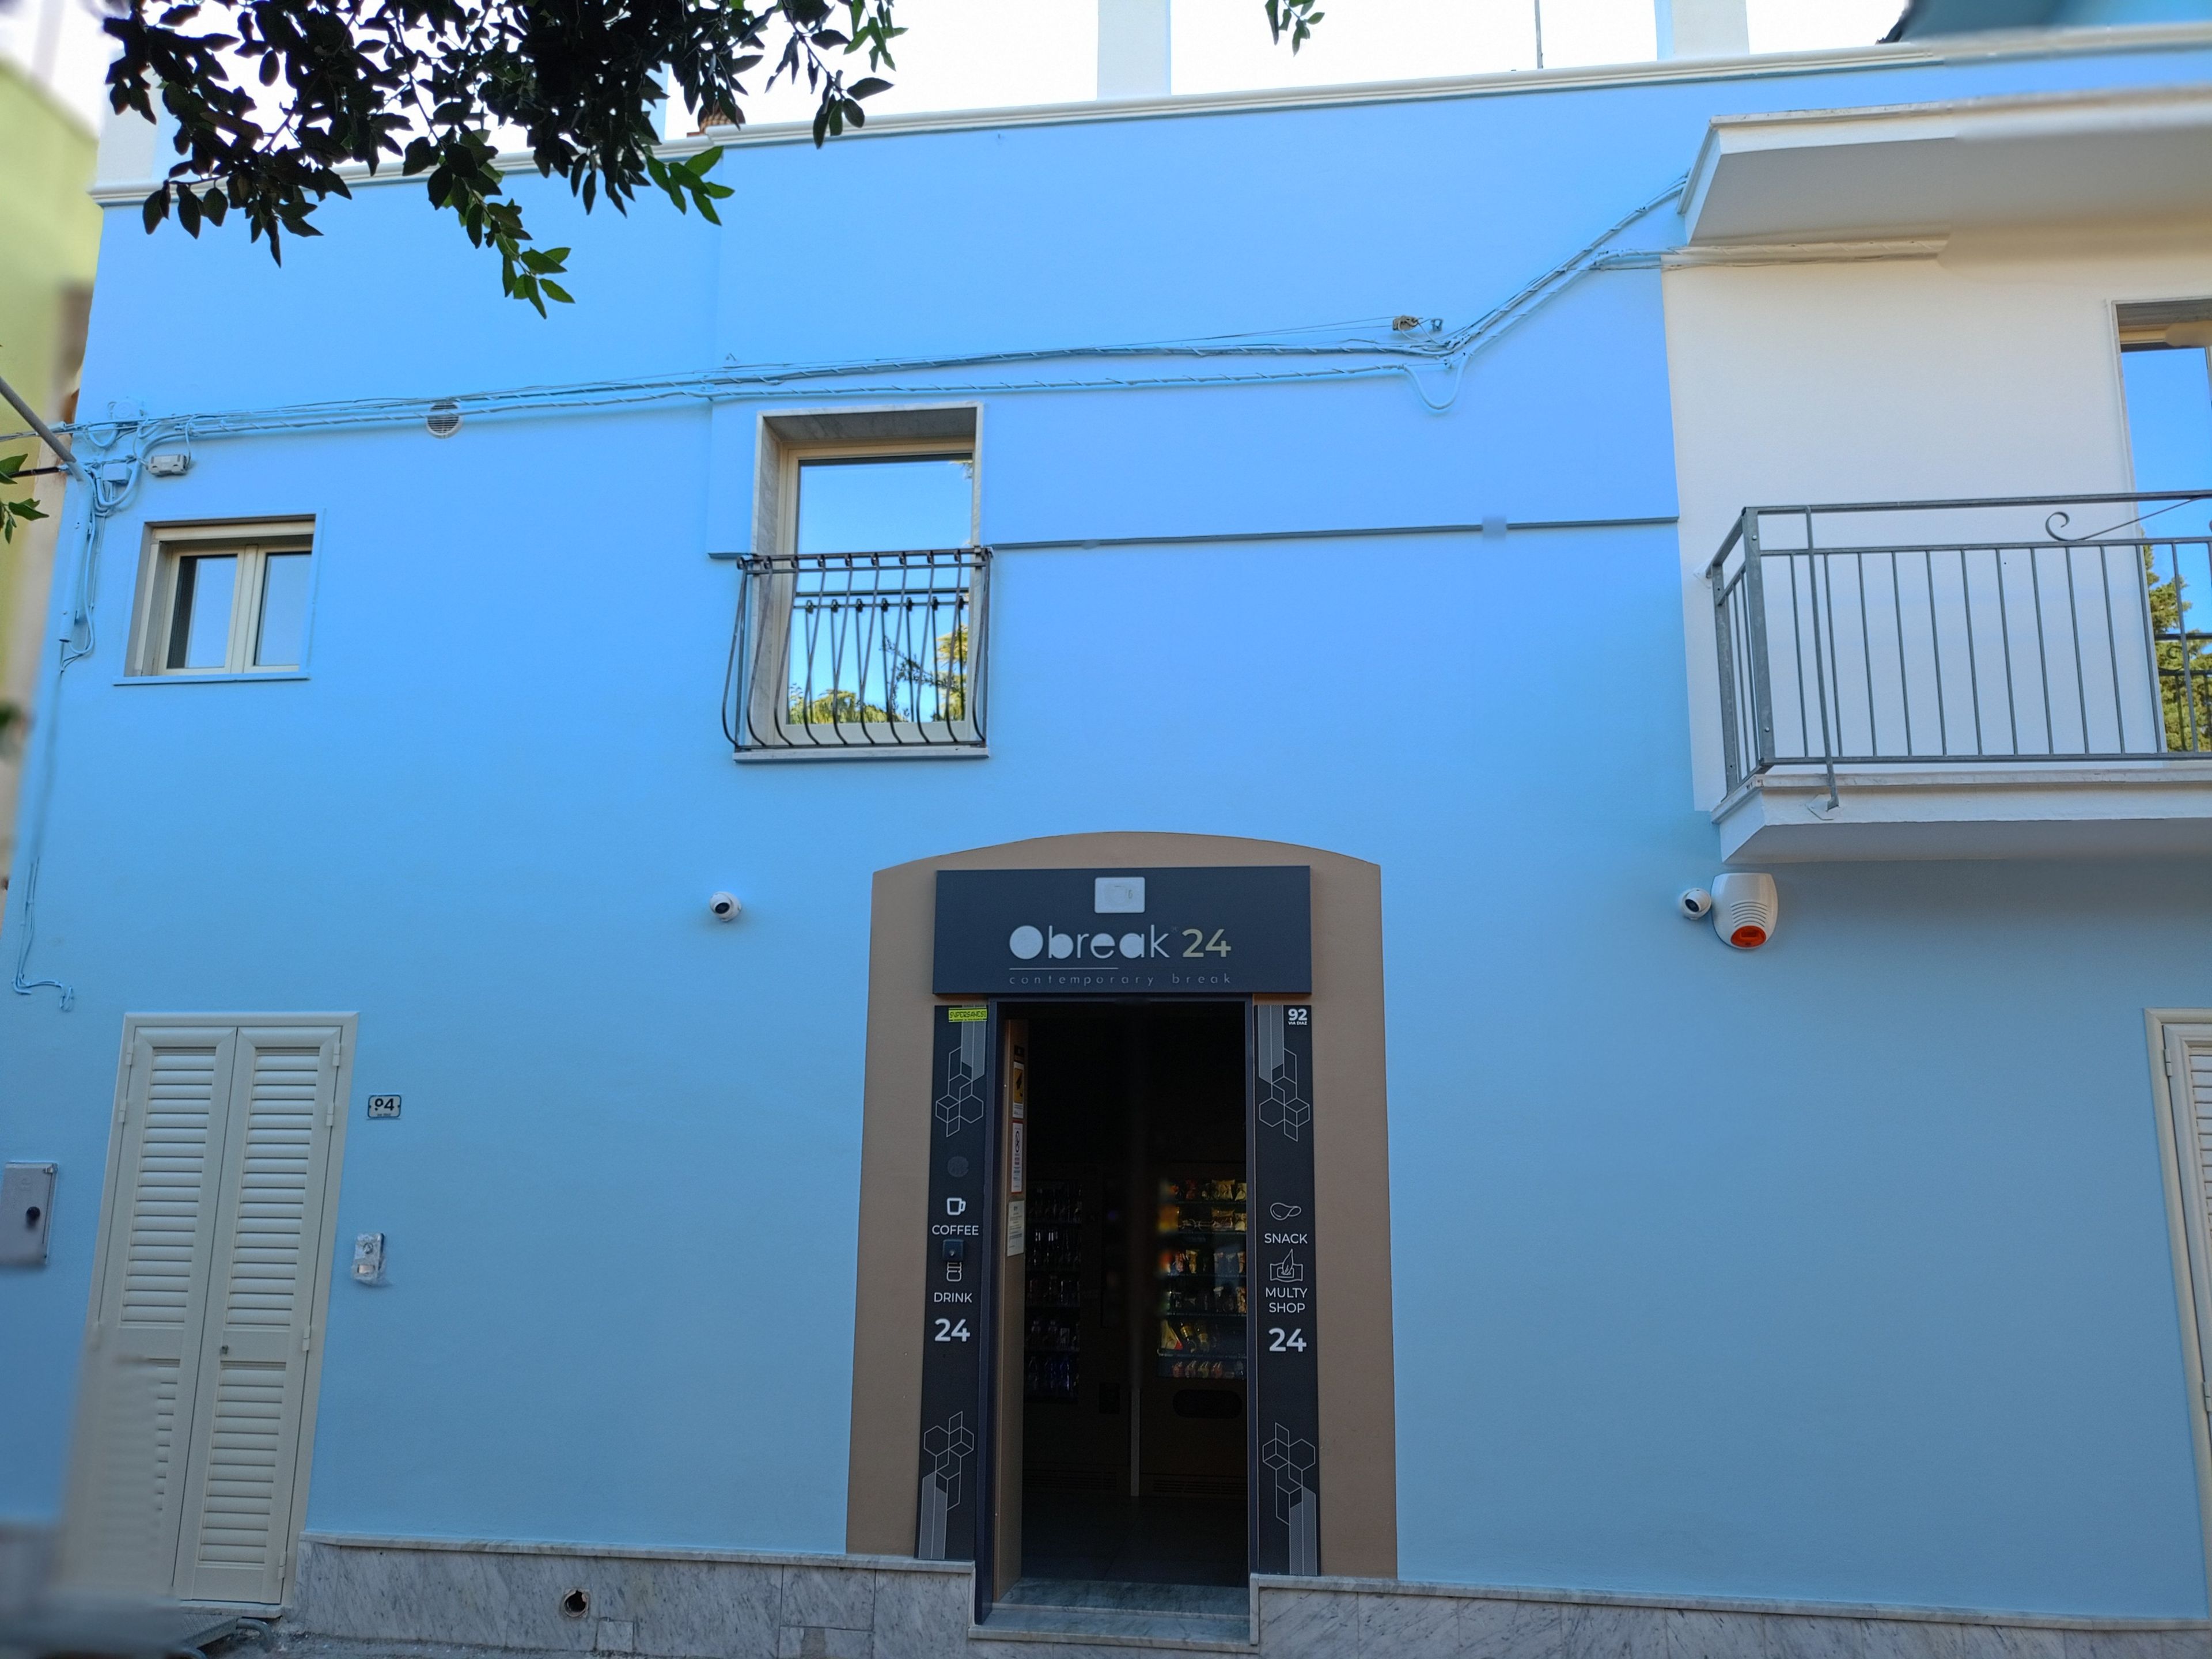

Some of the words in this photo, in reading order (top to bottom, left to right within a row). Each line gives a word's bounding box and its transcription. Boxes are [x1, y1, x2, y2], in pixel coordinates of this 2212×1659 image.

[1181, 929, 1232, 958] 24
[1009, 974, 1154, 986] contemporary
[1172, 973, 1231, 984] break
[1288, 1009, 1308, 1021] 92
[374, 1098, 395, 1111] 94
[932, 1225, 979, 1235] COFFEE
[1264, 1233, 1308, 1244] SNACK
[934, 1292, 972, 1303] DRINK
[1266, 1287, 1308, 1298] MULTY
[1269, 1302, 1305, 1313] SHOP
[934, 1318, 971, 1342] 24
[1268, 1328, 1307, 1352] 24
